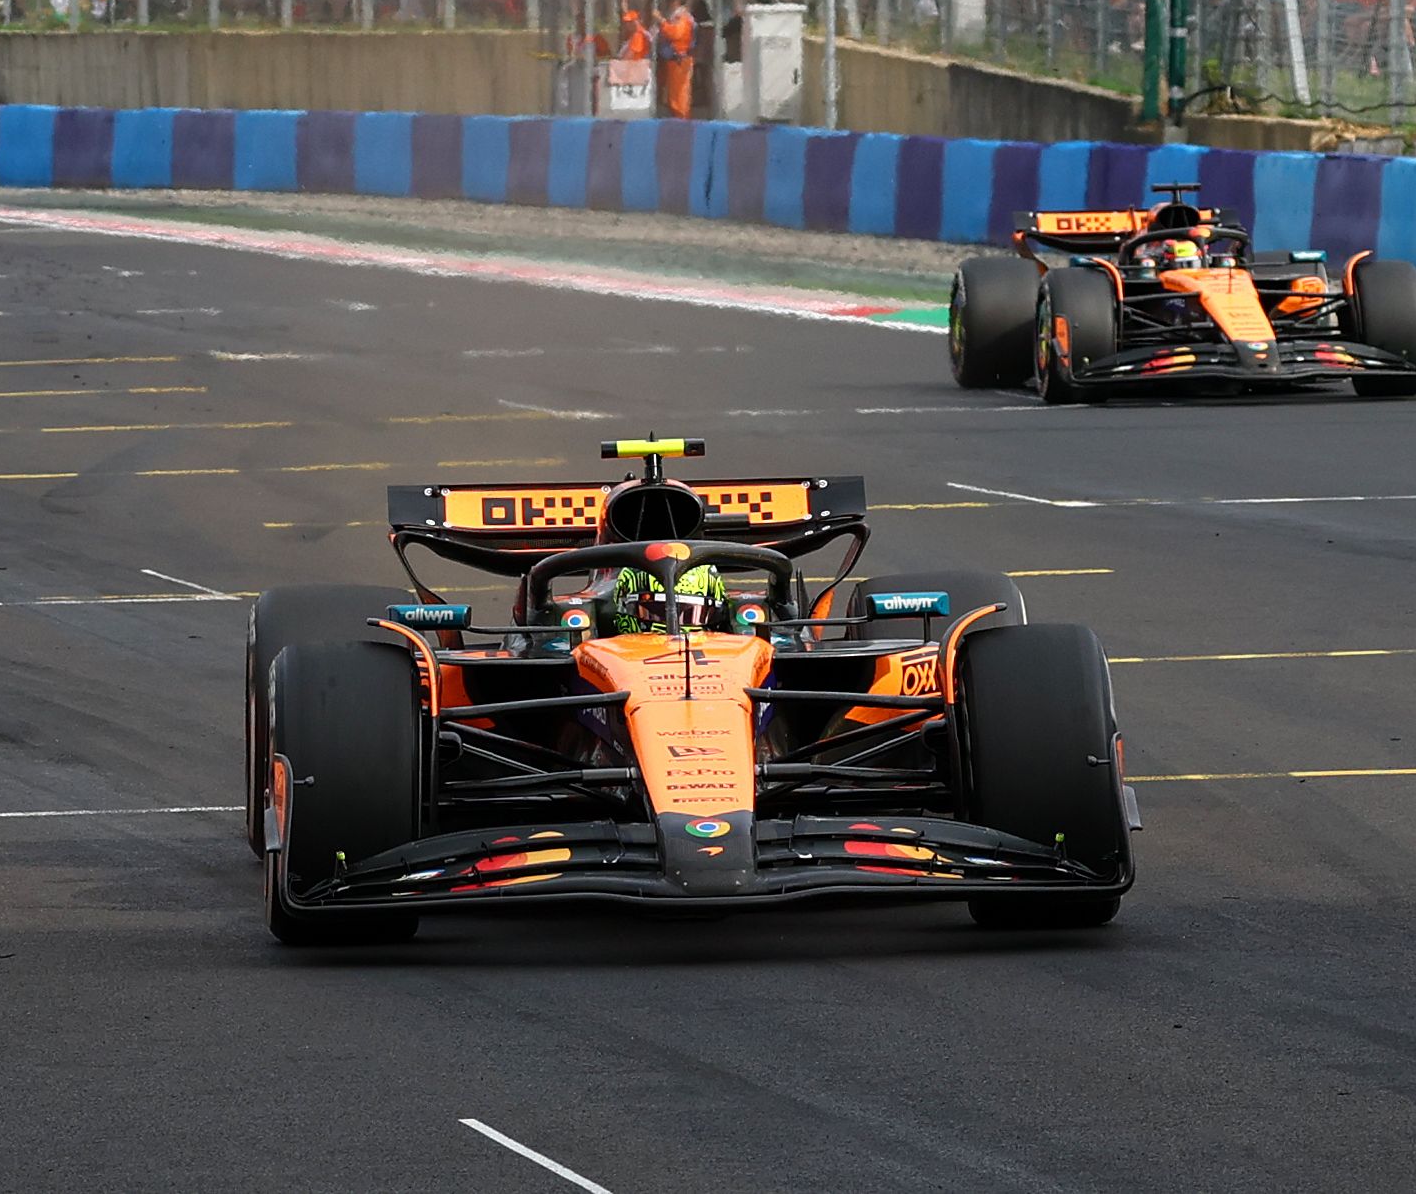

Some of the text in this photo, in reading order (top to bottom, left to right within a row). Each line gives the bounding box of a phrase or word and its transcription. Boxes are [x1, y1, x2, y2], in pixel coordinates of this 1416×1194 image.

[482, 497, 596, 525] OKX
[884, 595, 933, 611] allwyn
[405, 607, 454, 624] allwyn
[643, 649, 723, 666] 4
[648, 672, 722, 684] allwyn
[655, 683, 719, 694] Hilon
[656, 728, 732, 737] webex
[666, 769, 735, 777] FxPro
